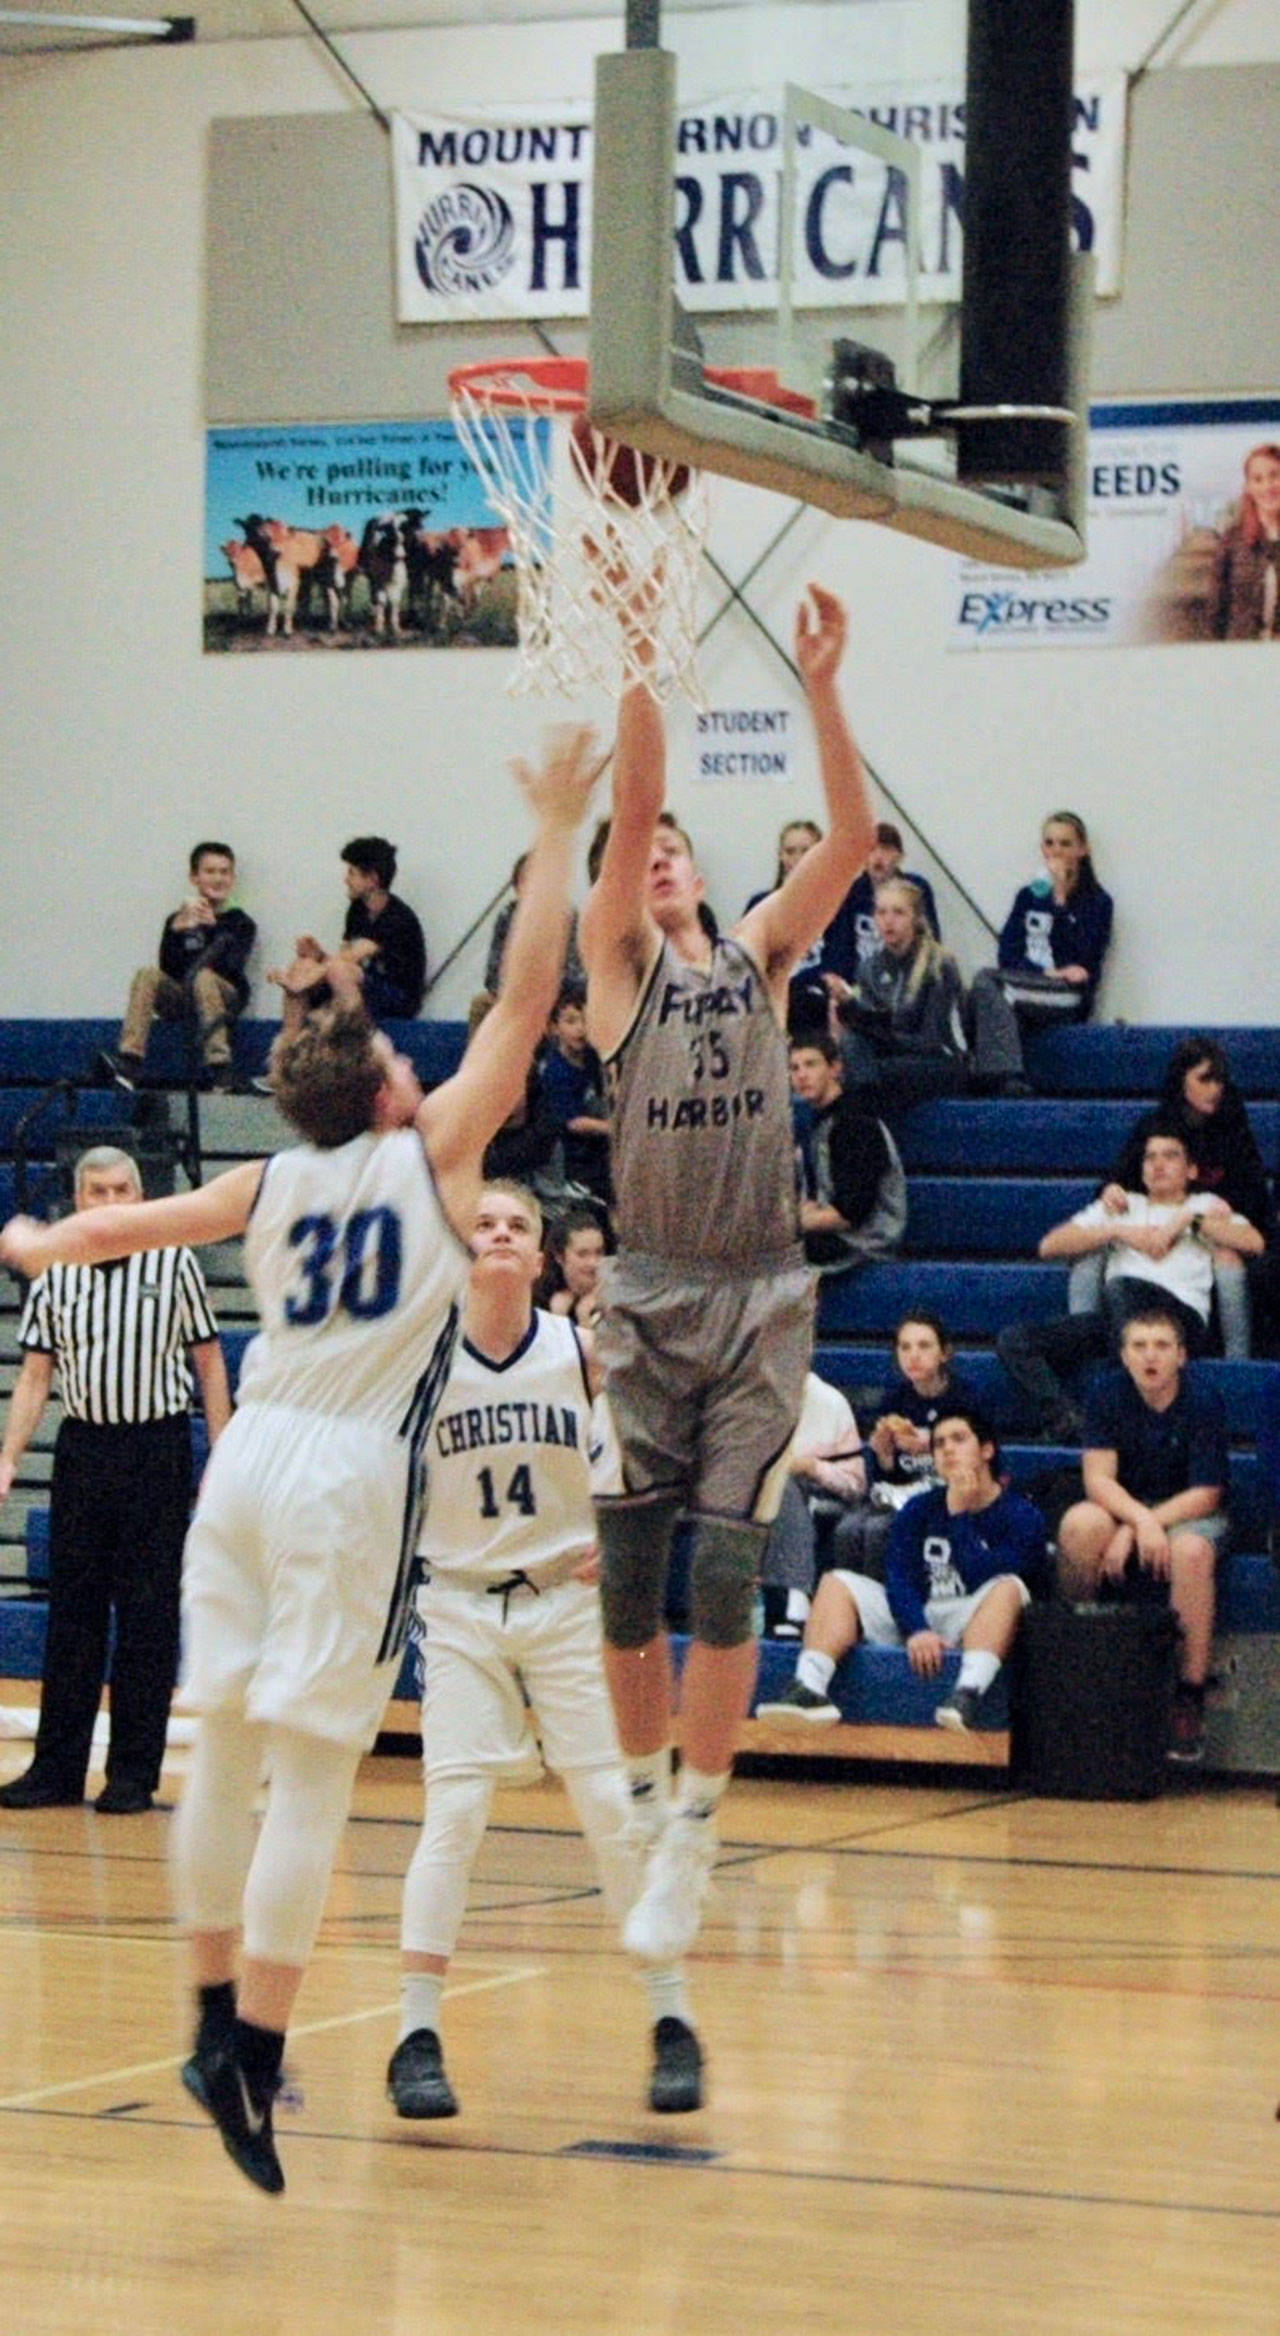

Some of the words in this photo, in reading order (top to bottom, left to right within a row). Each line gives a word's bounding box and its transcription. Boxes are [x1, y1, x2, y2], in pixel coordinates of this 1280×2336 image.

[416, 124, 591, 169] MOUNT
[528, 152, 1095, 291] HRRCANS
[256, 461, 318, 480] We're
[327, 456, 411, 483] pulling
[419, 457, 451, 476] for
[1092, 463, 1181, 498] EEDS
[307, 484, 449, 507] Hurricanes!
[697, 711, 789, 733] STUDENT
[700, 754, 787, 775] SECTION
[284, 1206, 403, 1325] 30
[435, 1402, 579, 1457] CHRISTIAN
[476, 1463, 537, 1519] 14
